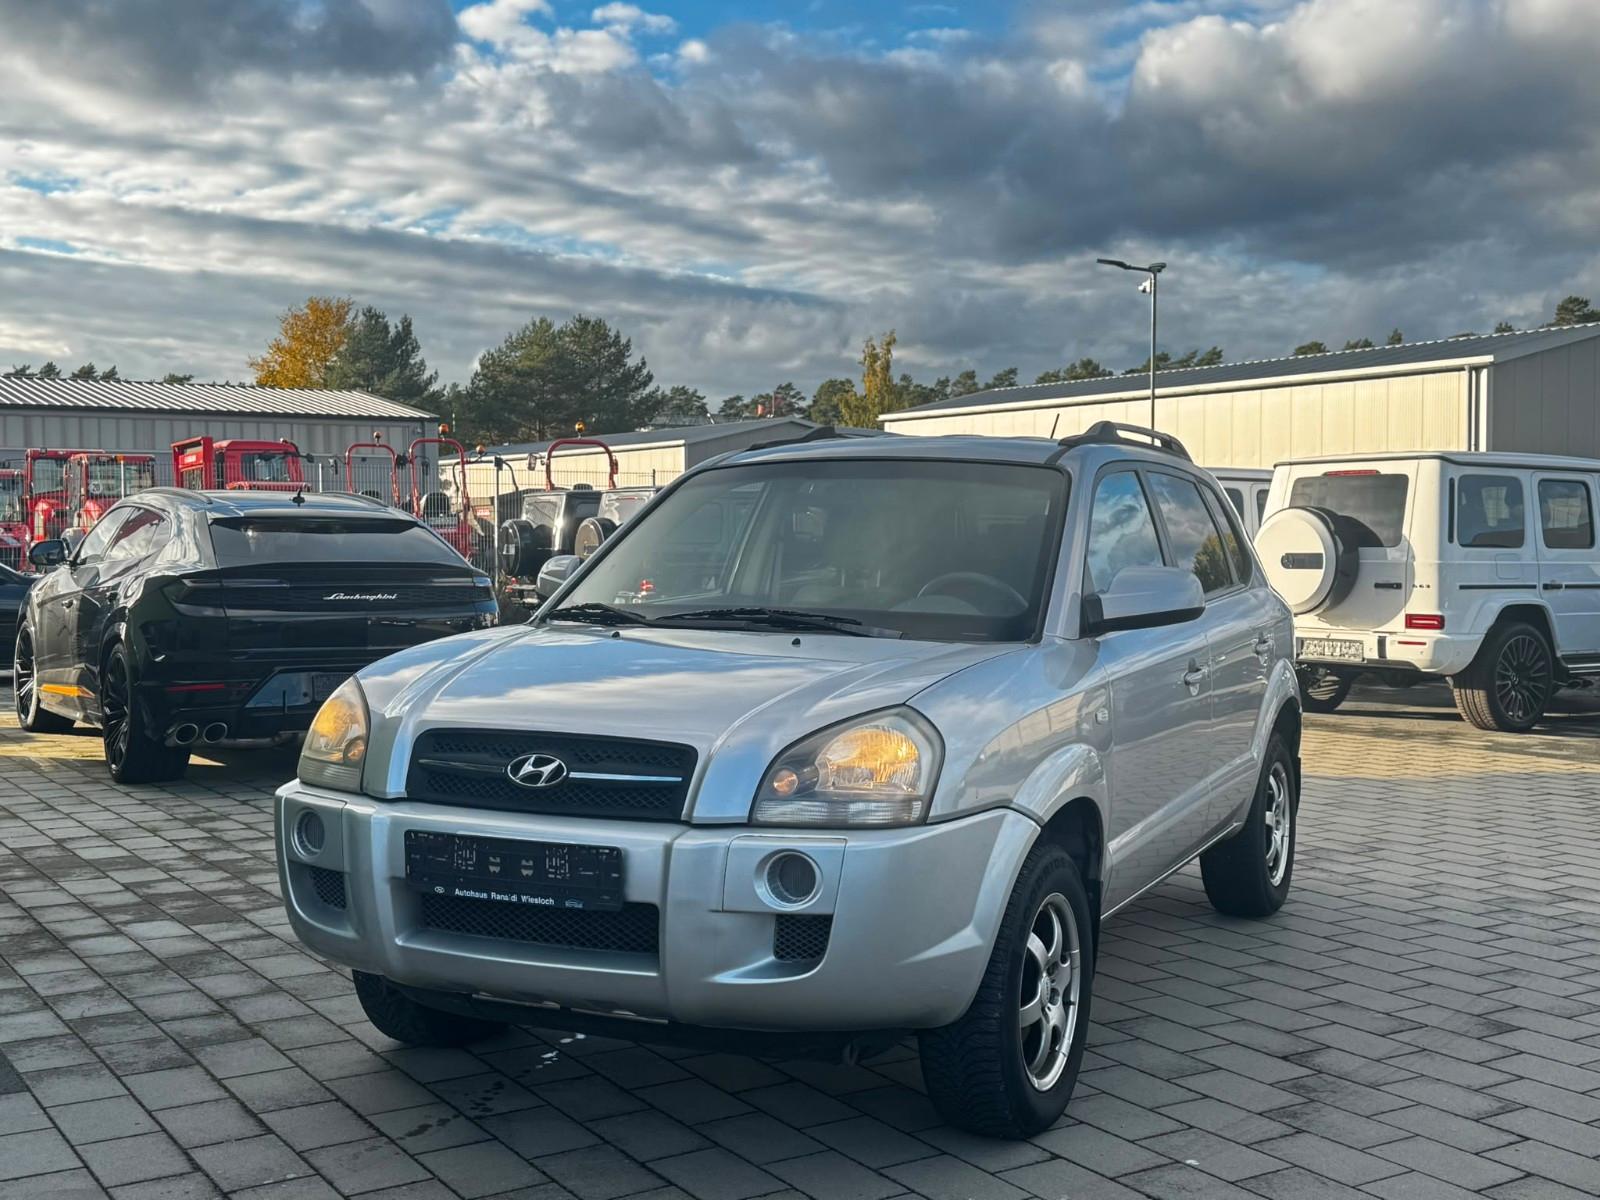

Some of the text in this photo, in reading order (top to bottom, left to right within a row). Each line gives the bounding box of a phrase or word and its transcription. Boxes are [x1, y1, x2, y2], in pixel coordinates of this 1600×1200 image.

[322, 592, 398, 602] Lamborghini
[455, 888, 488, 899] Autohaus
[521, 894, 555, 905] Wiesloch
